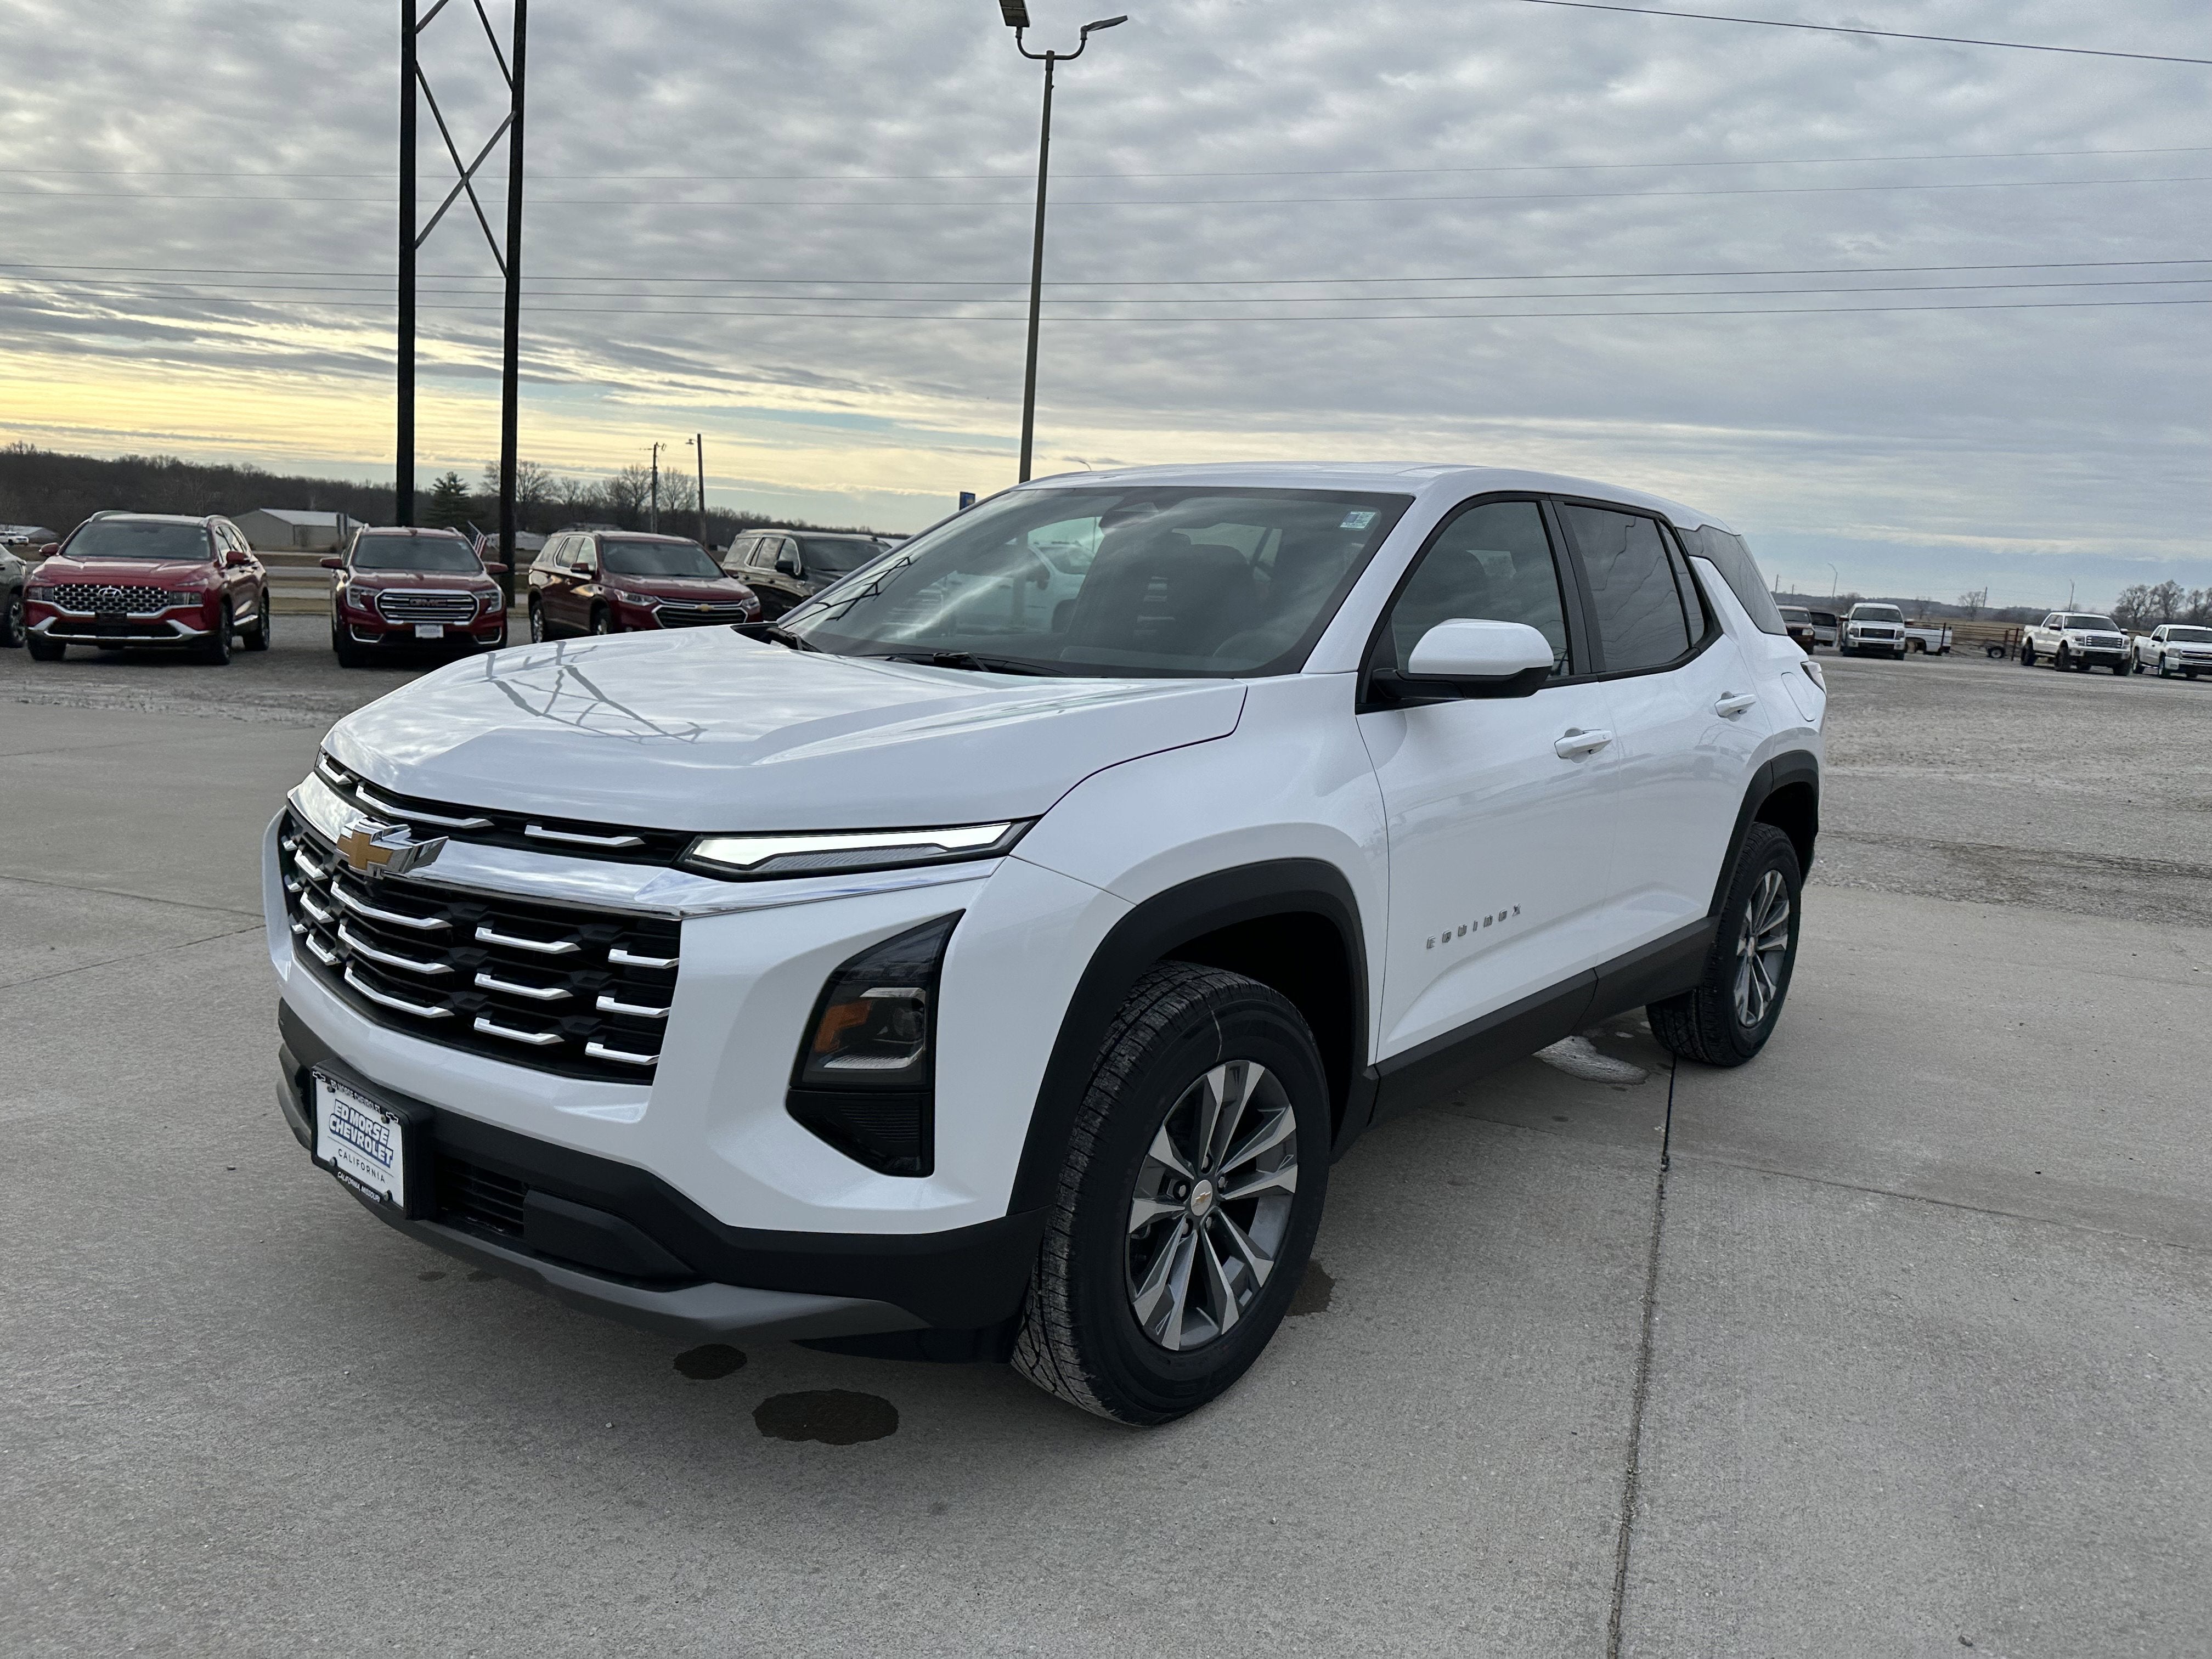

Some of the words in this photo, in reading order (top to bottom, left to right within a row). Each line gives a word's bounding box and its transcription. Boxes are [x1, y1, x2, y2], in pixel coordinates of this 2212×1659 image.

[1426, 904, 1521, 949] EQUINOX
[329, 1114, 393, 1168] CHEVROLET
[334, 1099, 350, 1121] ED
[349, 1107, 390, 1147] MORSE
[338, 1149, 385, 1183] CALIFORNIA
